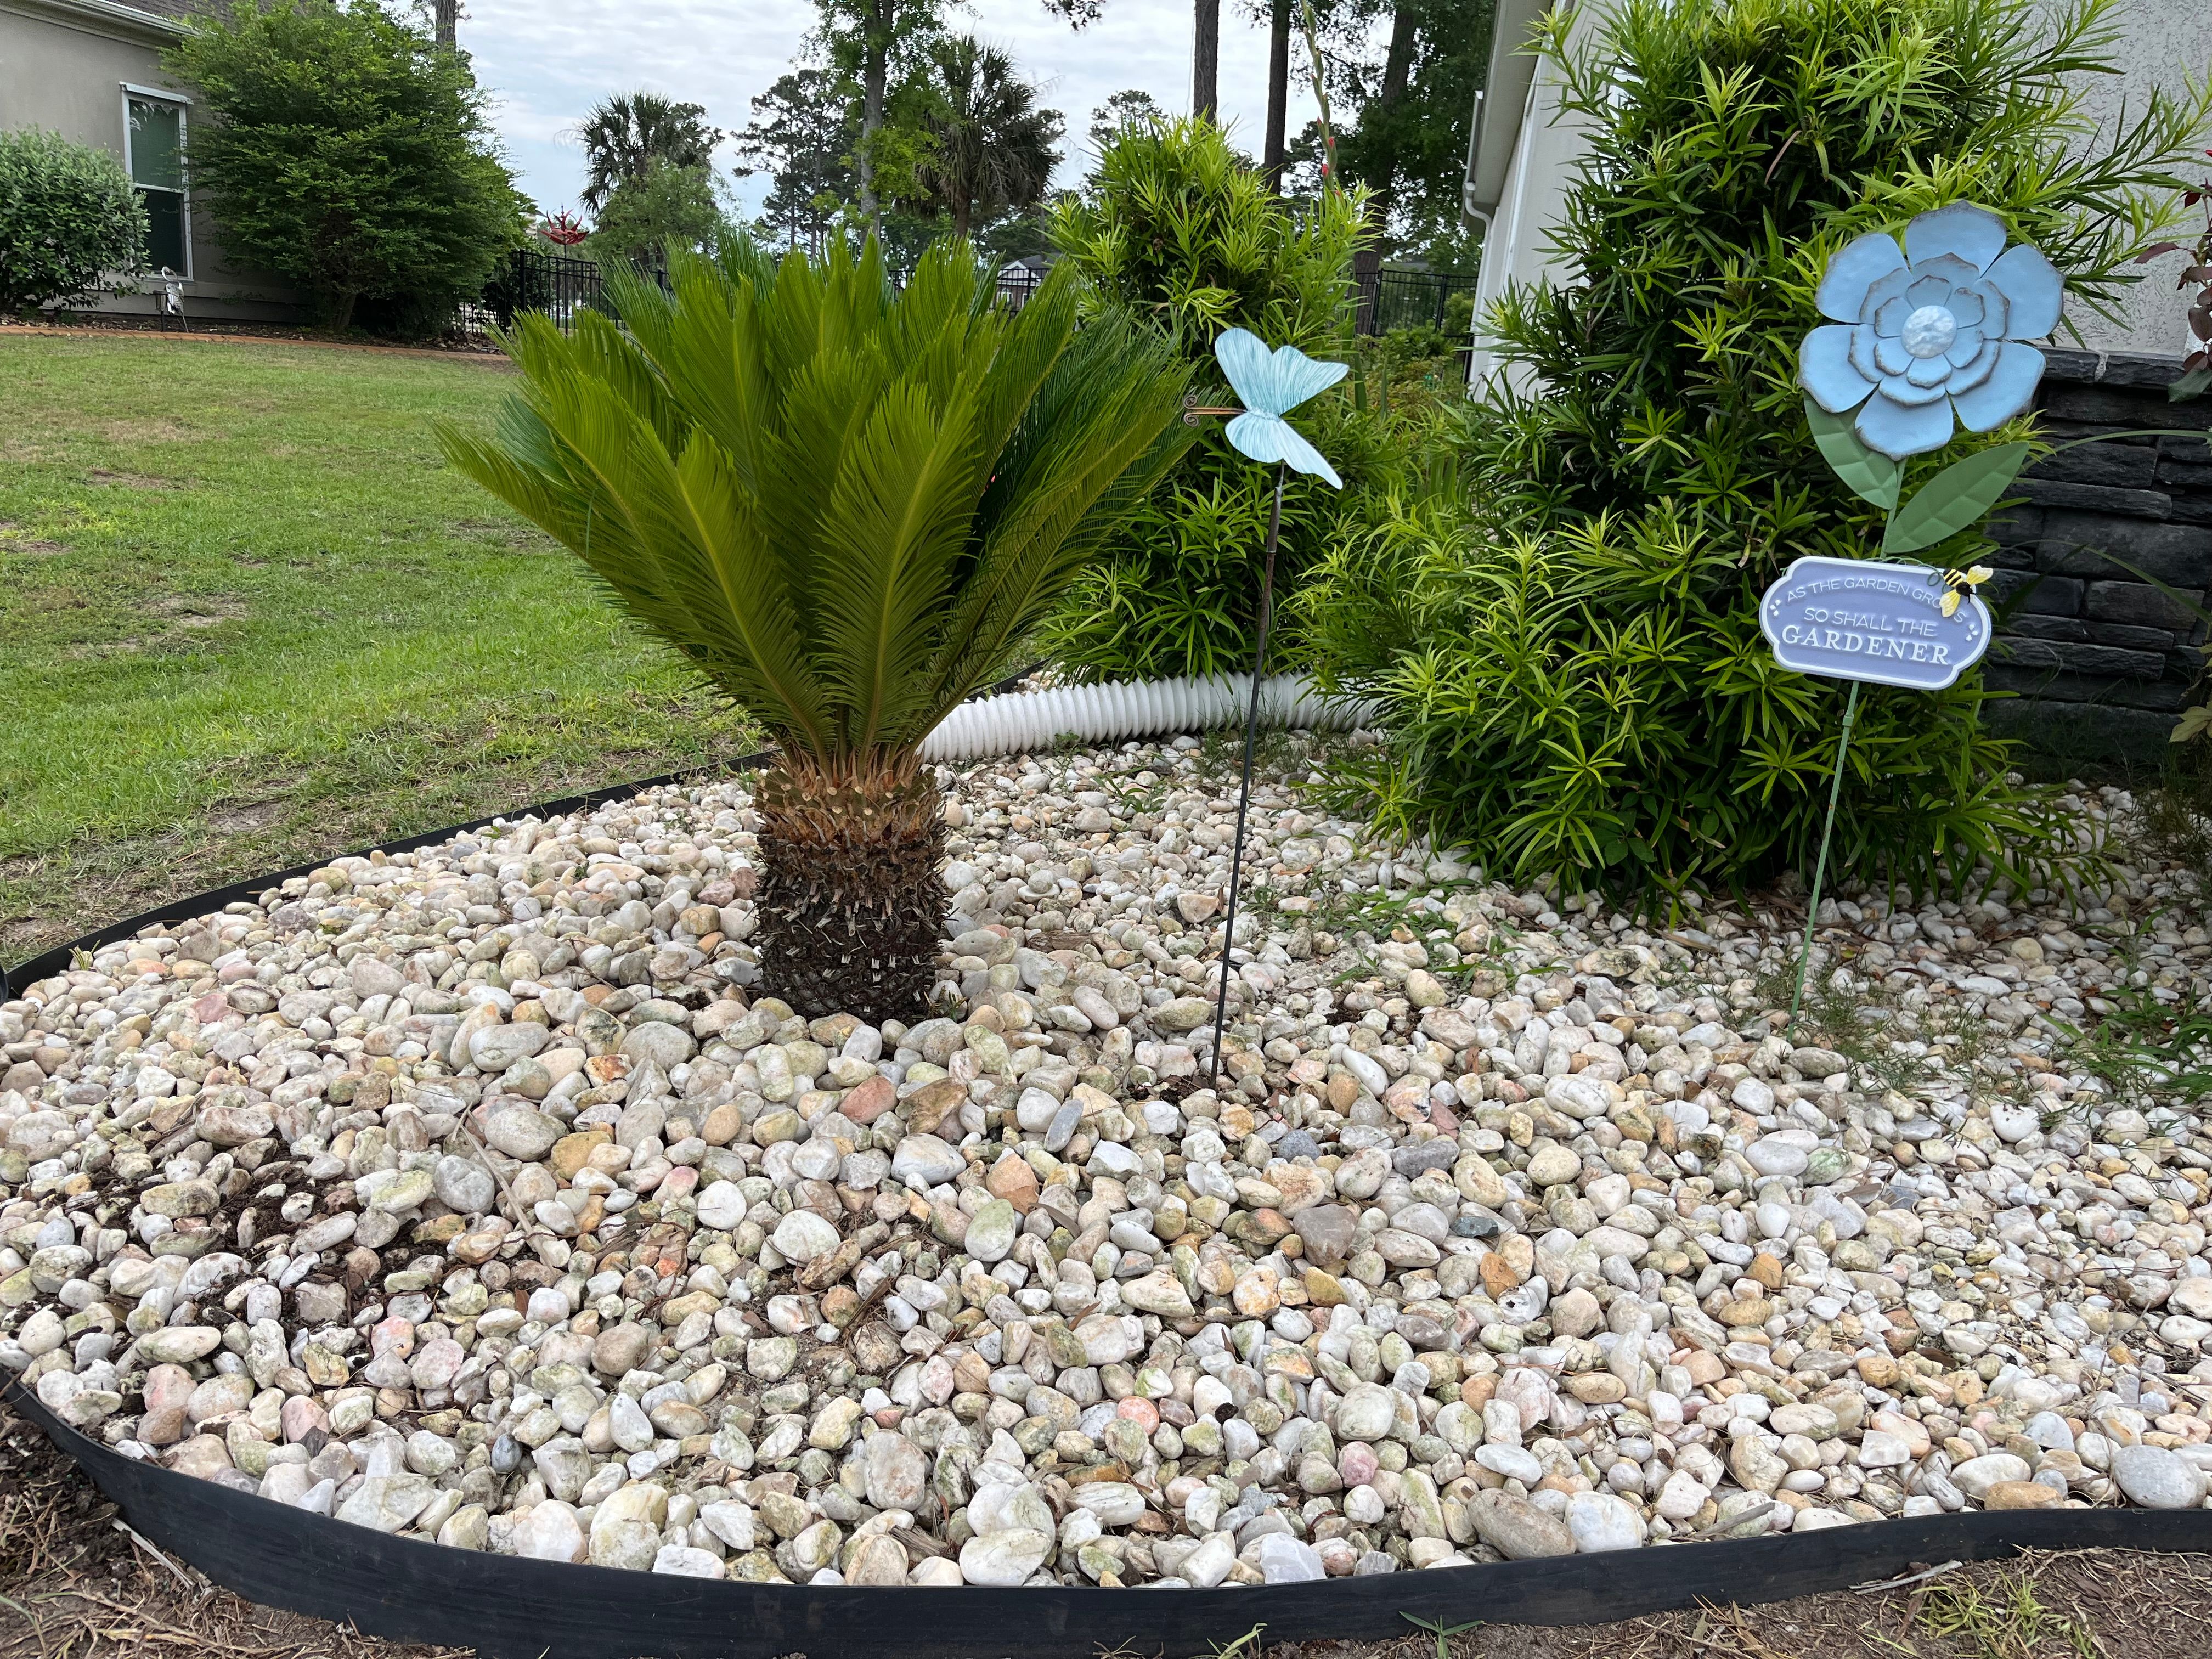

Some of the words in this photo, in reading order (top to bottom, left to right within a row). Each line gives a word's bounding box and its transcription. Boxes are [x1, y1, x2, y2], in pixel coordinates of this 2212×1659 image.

[1787, 587, 1807, 602] AS
[1809, 579, 1841, 594] THE
[1844, 578, 1910, 595] GARDEN
[1912, 588, 1967, 623] GROS
[1804, 607, 1829, 623] SO
[1832, 611, 1892, 631] SHALL
[1897, 619, 1938, 636] THE
[1781, 624, 1949, 665] GARDENER
